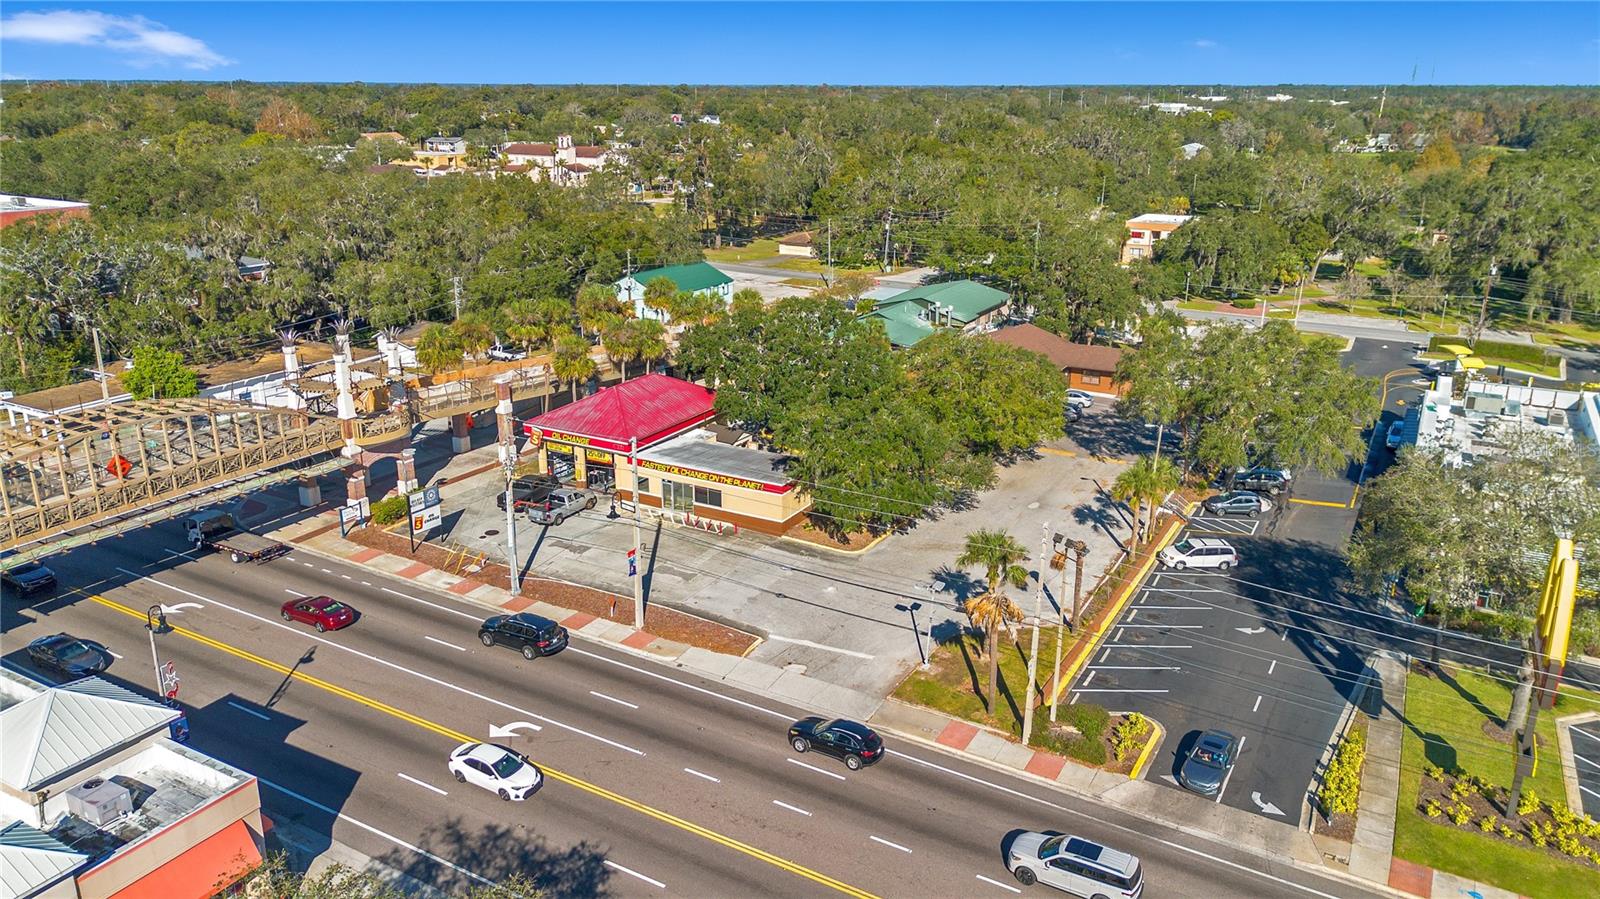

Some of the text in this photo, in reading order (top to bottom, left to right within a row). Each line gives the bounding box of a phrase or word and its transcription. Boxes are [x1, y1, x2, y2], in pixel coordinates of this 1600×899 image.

[531, 434, 539, 445] 5
[551, 432, 561, 440] OIL
[562, 434, 590, 445] CHANGE
[642, 461, 670, 472] FASTEST
[670, 467, 679, 475] OIL
[681, 469, 709, 480] CHANGE
[709, 474, 720, 482] ON
[720, 476, 733, 485] THE
